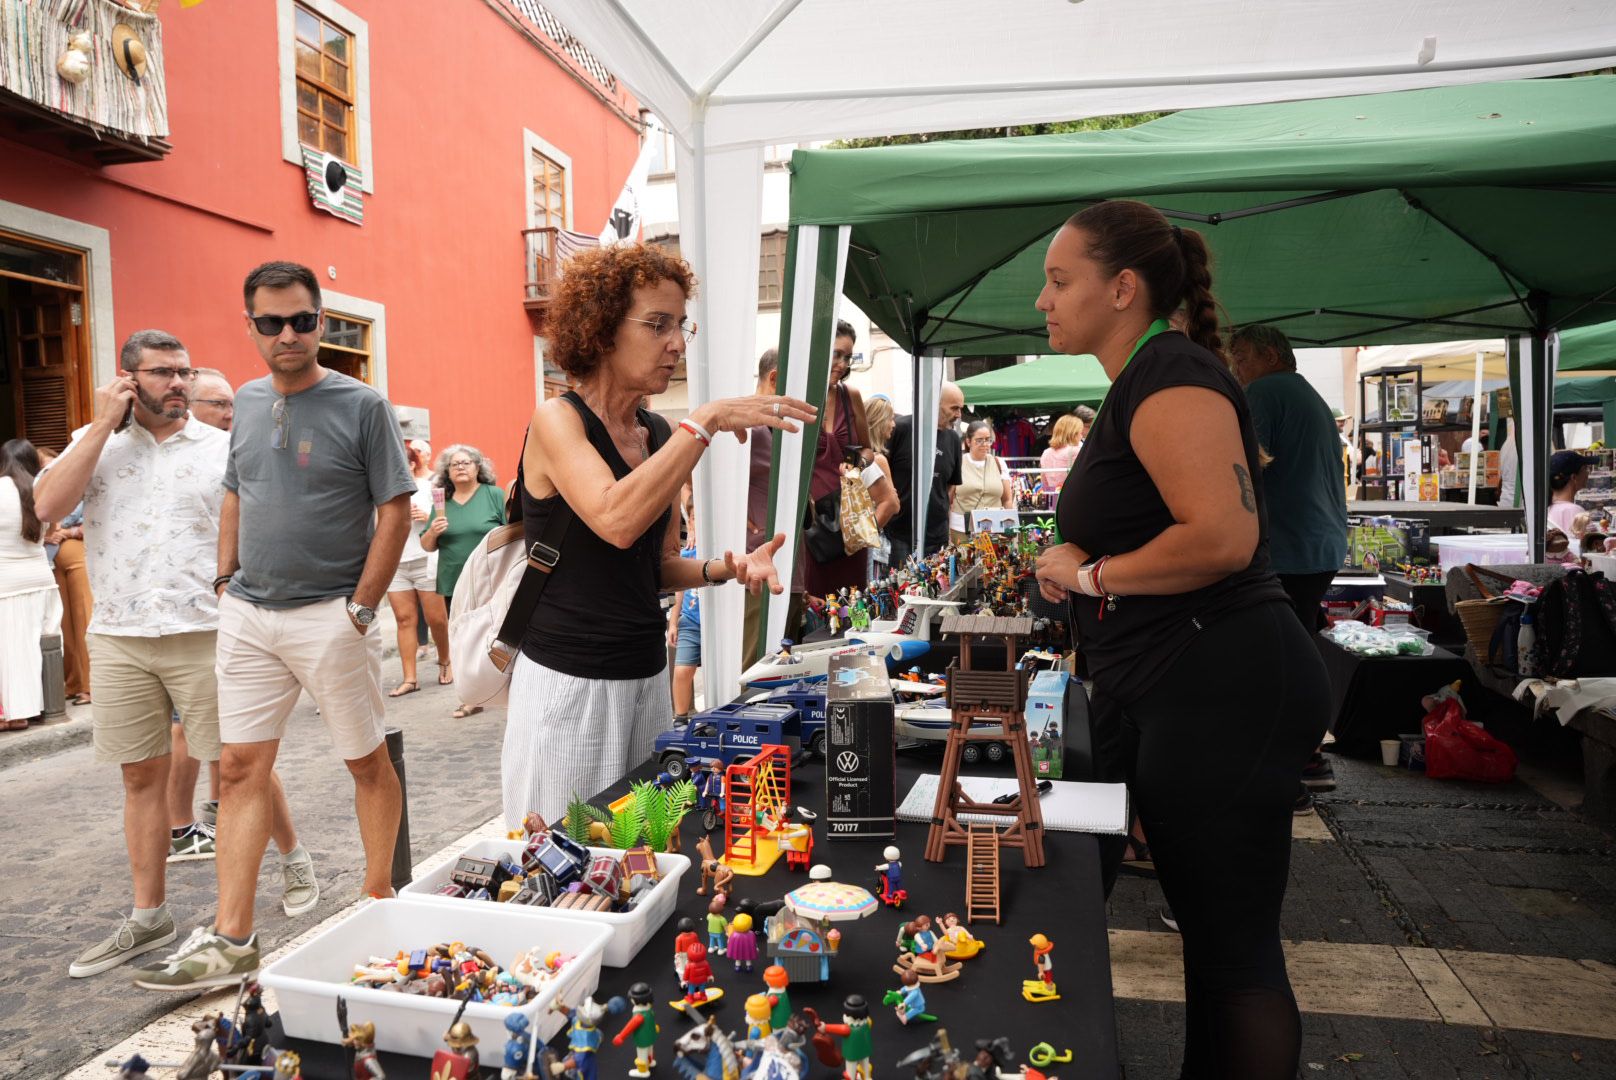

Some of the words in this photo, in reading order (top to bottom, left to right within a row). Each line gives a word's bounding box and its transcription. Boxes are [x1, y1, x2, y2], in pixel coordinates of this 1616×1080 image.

[811, 710, 826, 719] POLI
[732, 734, 759, 745] POLICE
[832, 823, 859, 832] 70177
